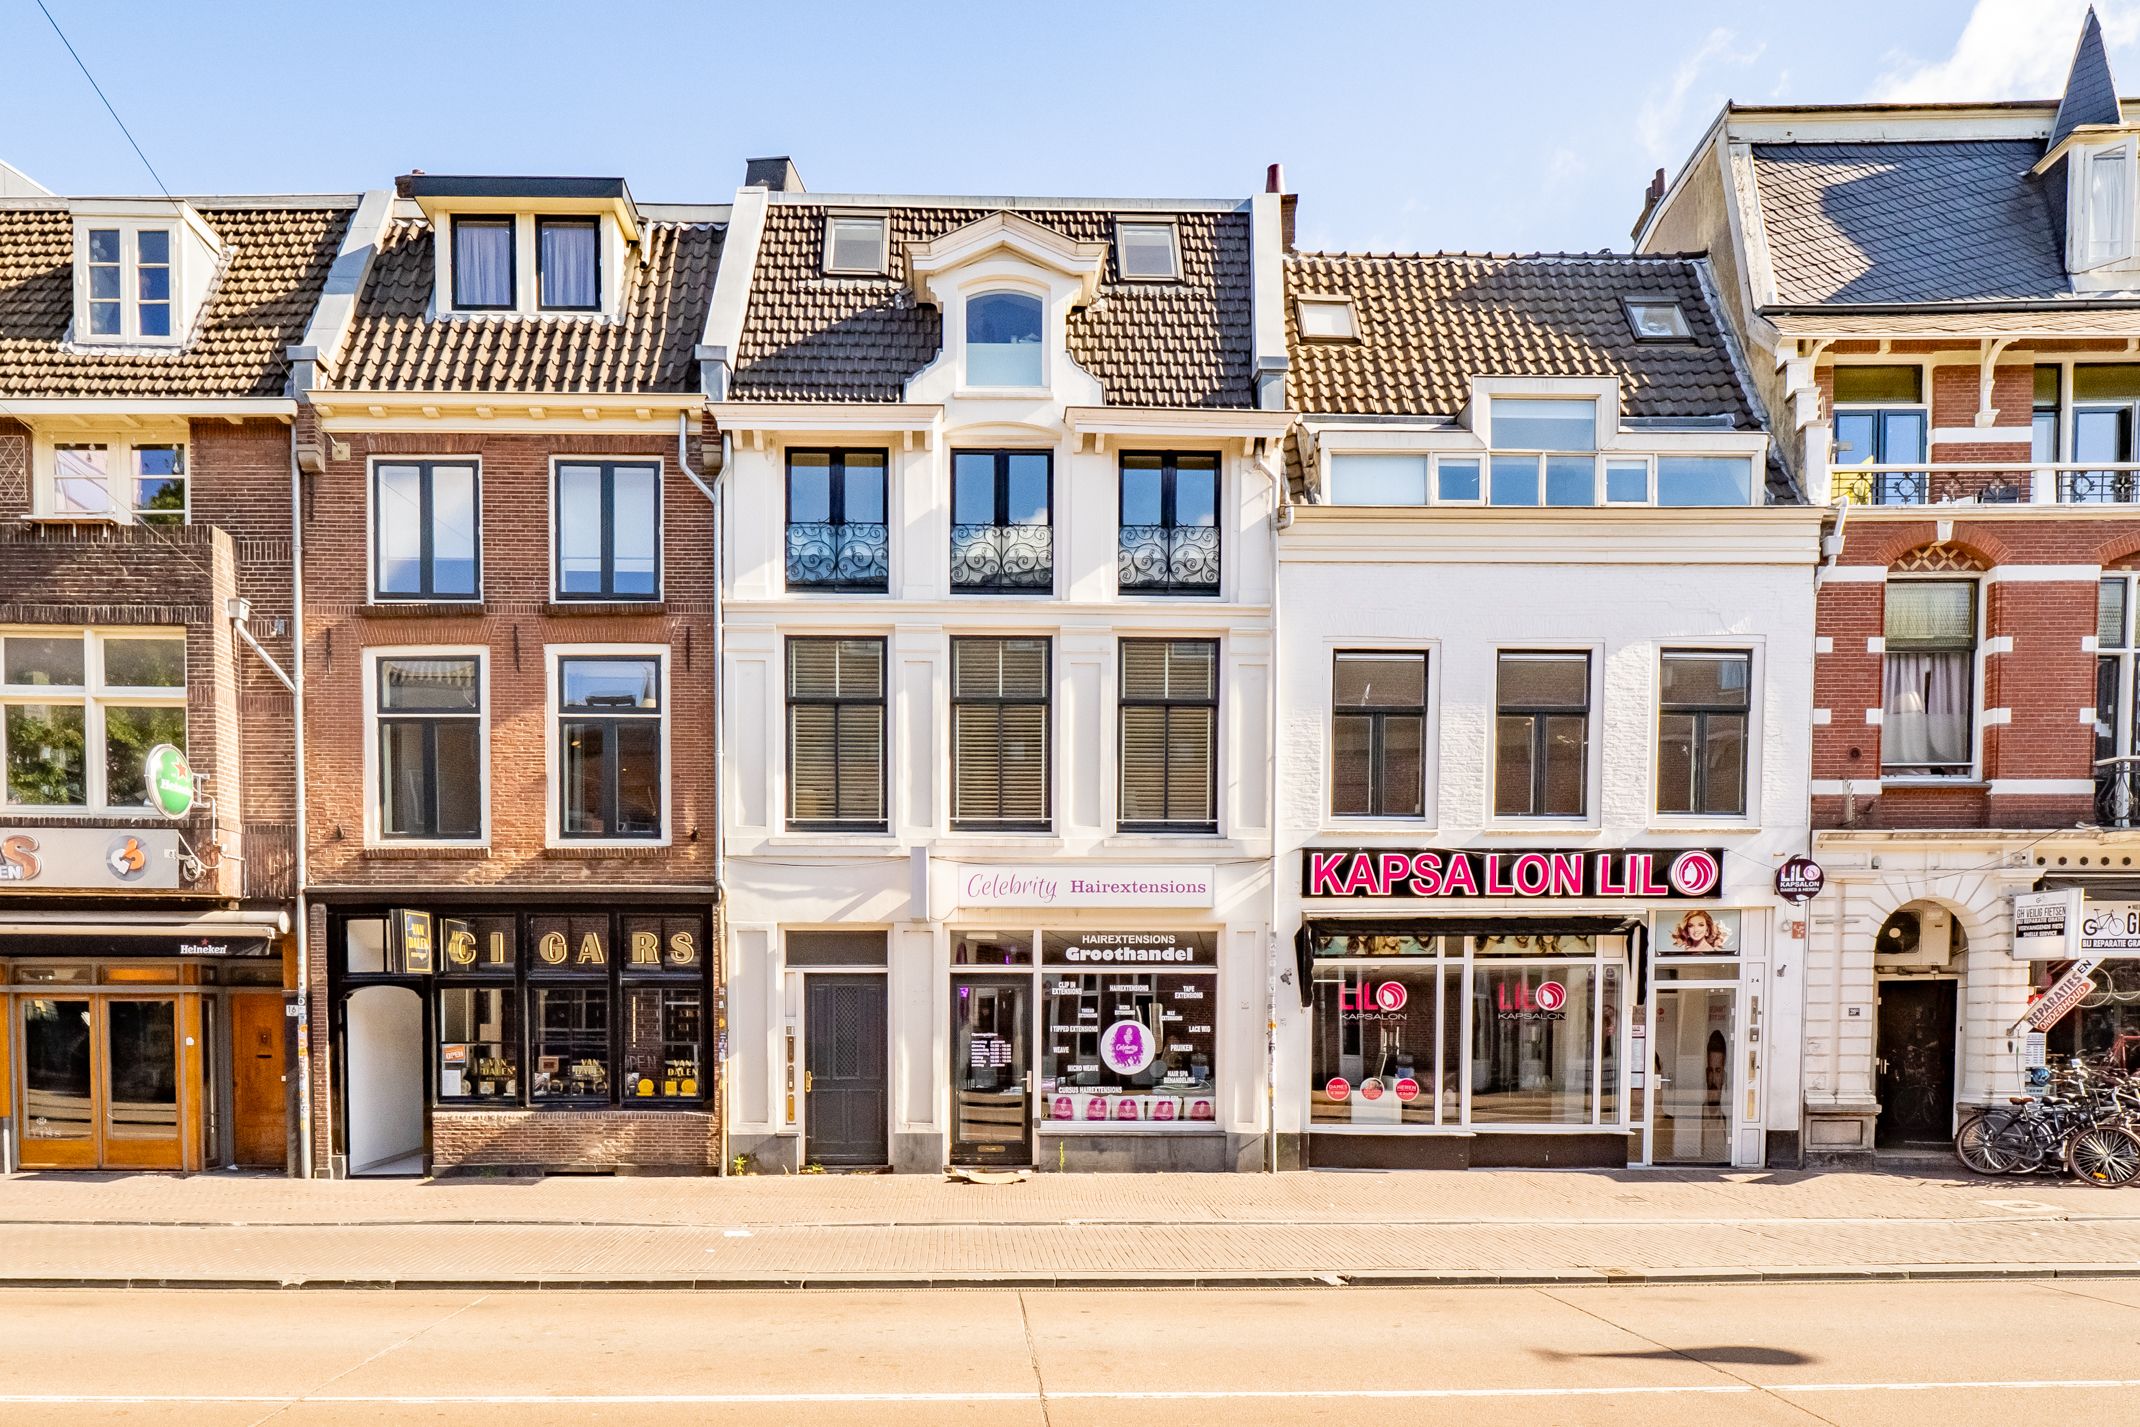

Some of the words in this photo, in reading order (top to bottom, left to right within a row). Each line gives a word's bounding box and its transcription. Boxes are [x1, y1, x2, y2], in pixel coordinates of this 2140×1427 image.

[1310, 853, 1584, 897] KAPSALON
[967, 873, 1059, 904] Celebrity
[1070, 879, 1207, 894] Hairextensions
[2026, 907, 2043, 918] VEILIG
[2044, 905, 2066, 917] FIETSEN
[1082, 934, 1176, 944] HAIREXTENSIONS
[2093, 939, 2126, 948] REPARATIE
[181, 944, 227, 954] Heineken
[1065, 947, 1193, 962] Groothandel
[1109, 984, 1149, 992] HAIREXTENSIONS
[2027, 972, 2083, 1027] REPARATIES
[2040, 985, 2086, 1030] ONDERHOUD
[1053, 1046, 1069, 1054] WEAVE
[488, 1058, 507, 1067] VAN
[581, 1058, 600, 1066] VAN
[673, 1059, 692, 1067] VAN
[483, 1067, 513, 1076] DALEN
[575, 1066, 606, 1075] DALEN
[667, 1067, 698, 1076] DALEN
